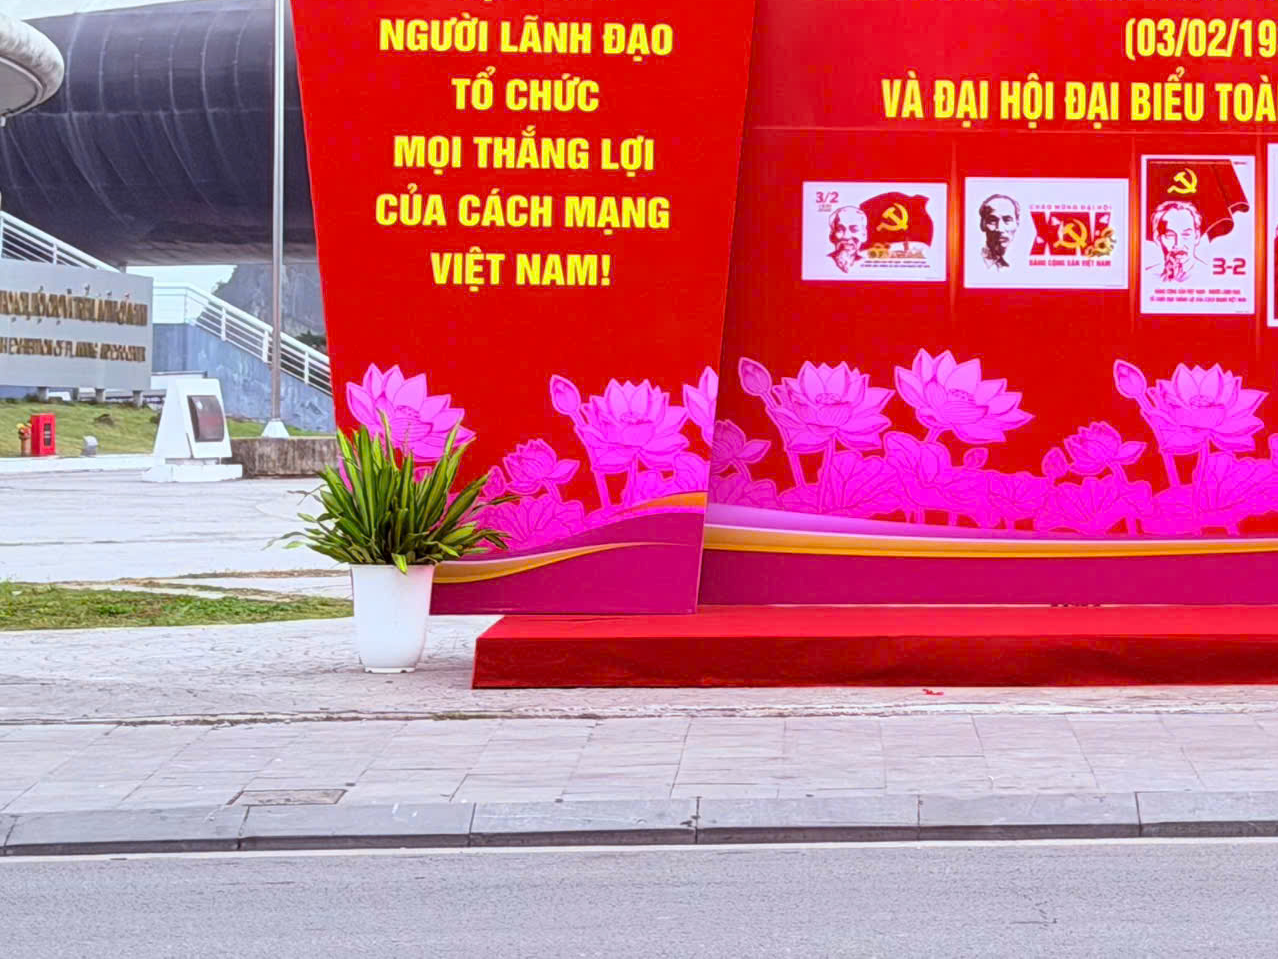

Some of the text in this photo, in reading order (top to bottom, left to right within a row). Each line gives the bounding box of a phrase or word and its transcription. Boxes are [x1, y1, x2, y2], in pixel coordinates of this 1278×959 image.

[379, 12, 673, 62] NGƯỜI LÃNH ĐẠO
[451, 65, 600, 112] TỔ CHỨC
[881, 70, 925, 119] VÀ
[933, 79, 989, 128] ĐẠI
[999, 72, 1055, 129] HỘI
[1063, 81, 1120, 130] ĐẠI
[1130, 66, 1205, 122] BIỂU
[393, 124, 655, 178] MỌI THẮNG LỢI
[375, 182, 670, 236] CỦA CÁCH MẠNG
[815, 191, 839, 203] 3/2
[430, 246, 611, 293] VIỆT NAM!
[1212, 257, 1247, 276] 3-2
